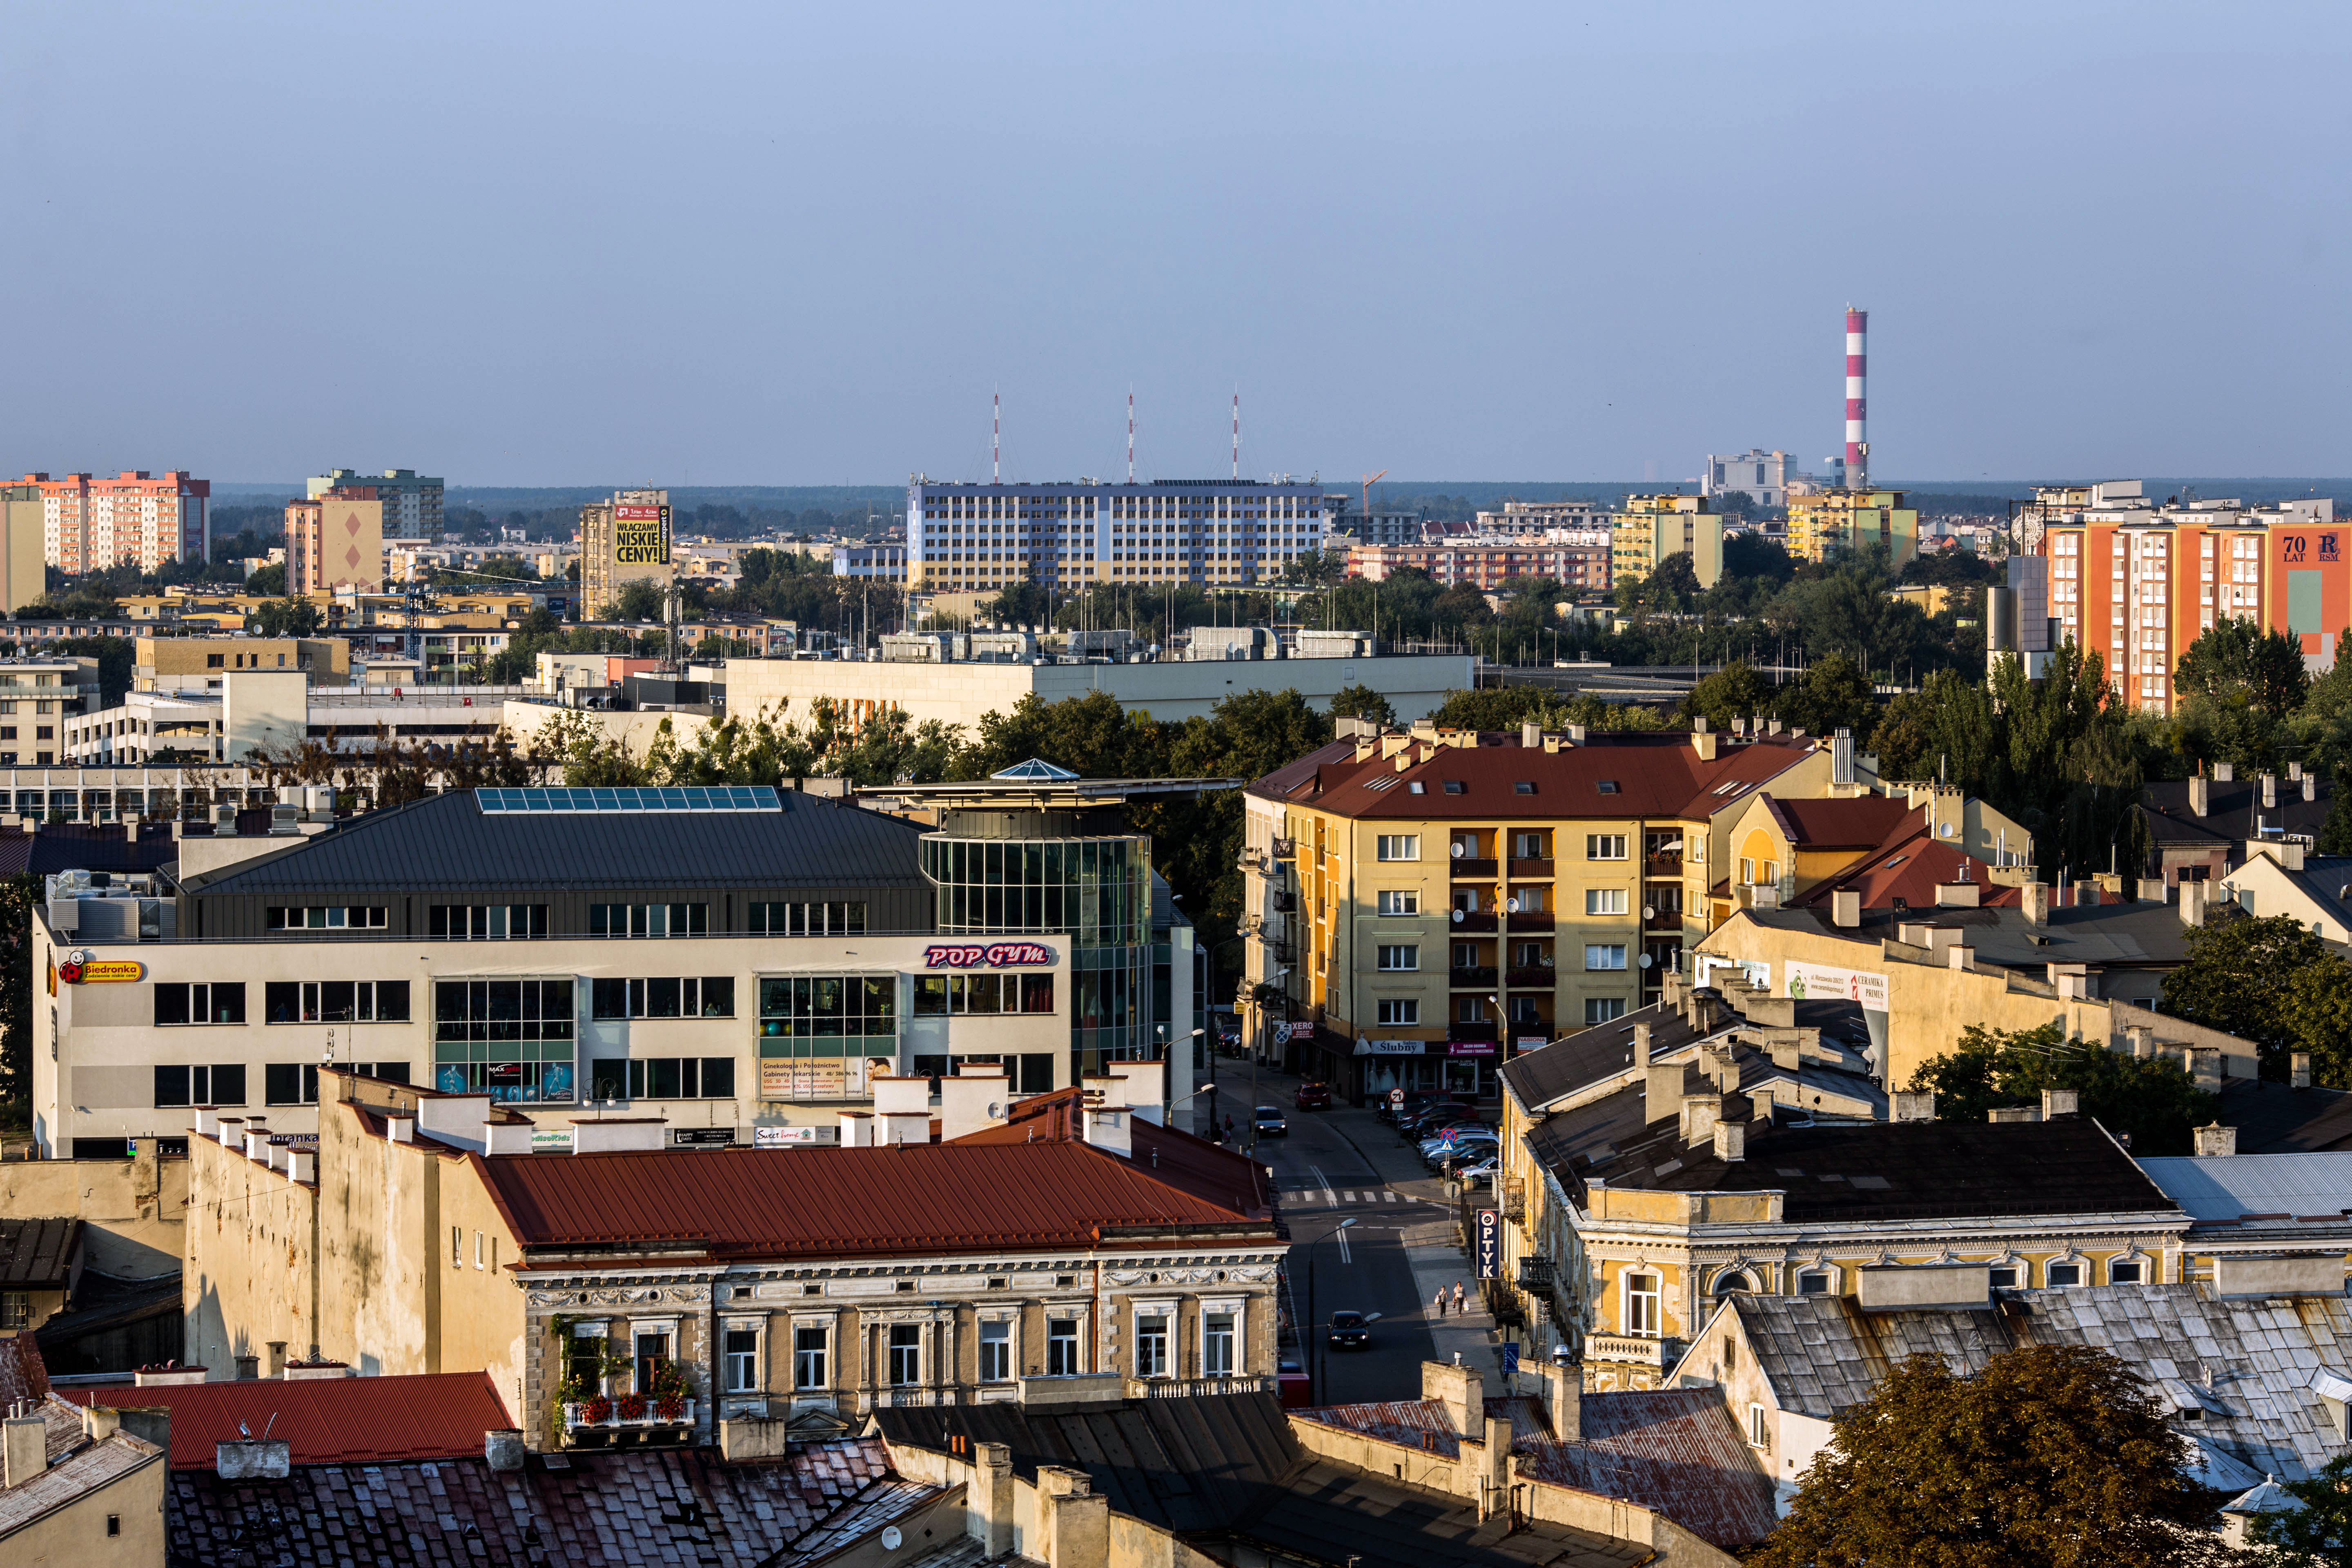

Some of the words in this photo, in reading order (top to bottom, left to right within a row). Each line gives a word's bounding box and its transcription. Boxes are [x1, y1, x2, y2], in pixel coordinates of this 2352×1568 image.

[617, 523, 658, 532] WŁĄCZAMY
[617, 532, 658, 546] NISKIE
[2283, 536, 2306, 553] 70
[617, 547, 658, 562] CENY!
[2283, 553, 2306, 562] LAT
[928, 947, 984, 965] POP
[986, 945, 1047, 964] GYM
[85, 965, 137, 973] Biedronka
[1858, 976, 1883, 987] CERAMIKA
[1811, 984, 1844, 995] www.ceramikaprimus.pl
[1866, 989, 1884, 999] PRIMUS
[1380, 1041, 1417, 1054] Ślubny
[757, 1129, 779, 1140] Sweet
[781, 1129, 800, 1139] home
[1481, 1213, 1494, 1277] OPTYK
